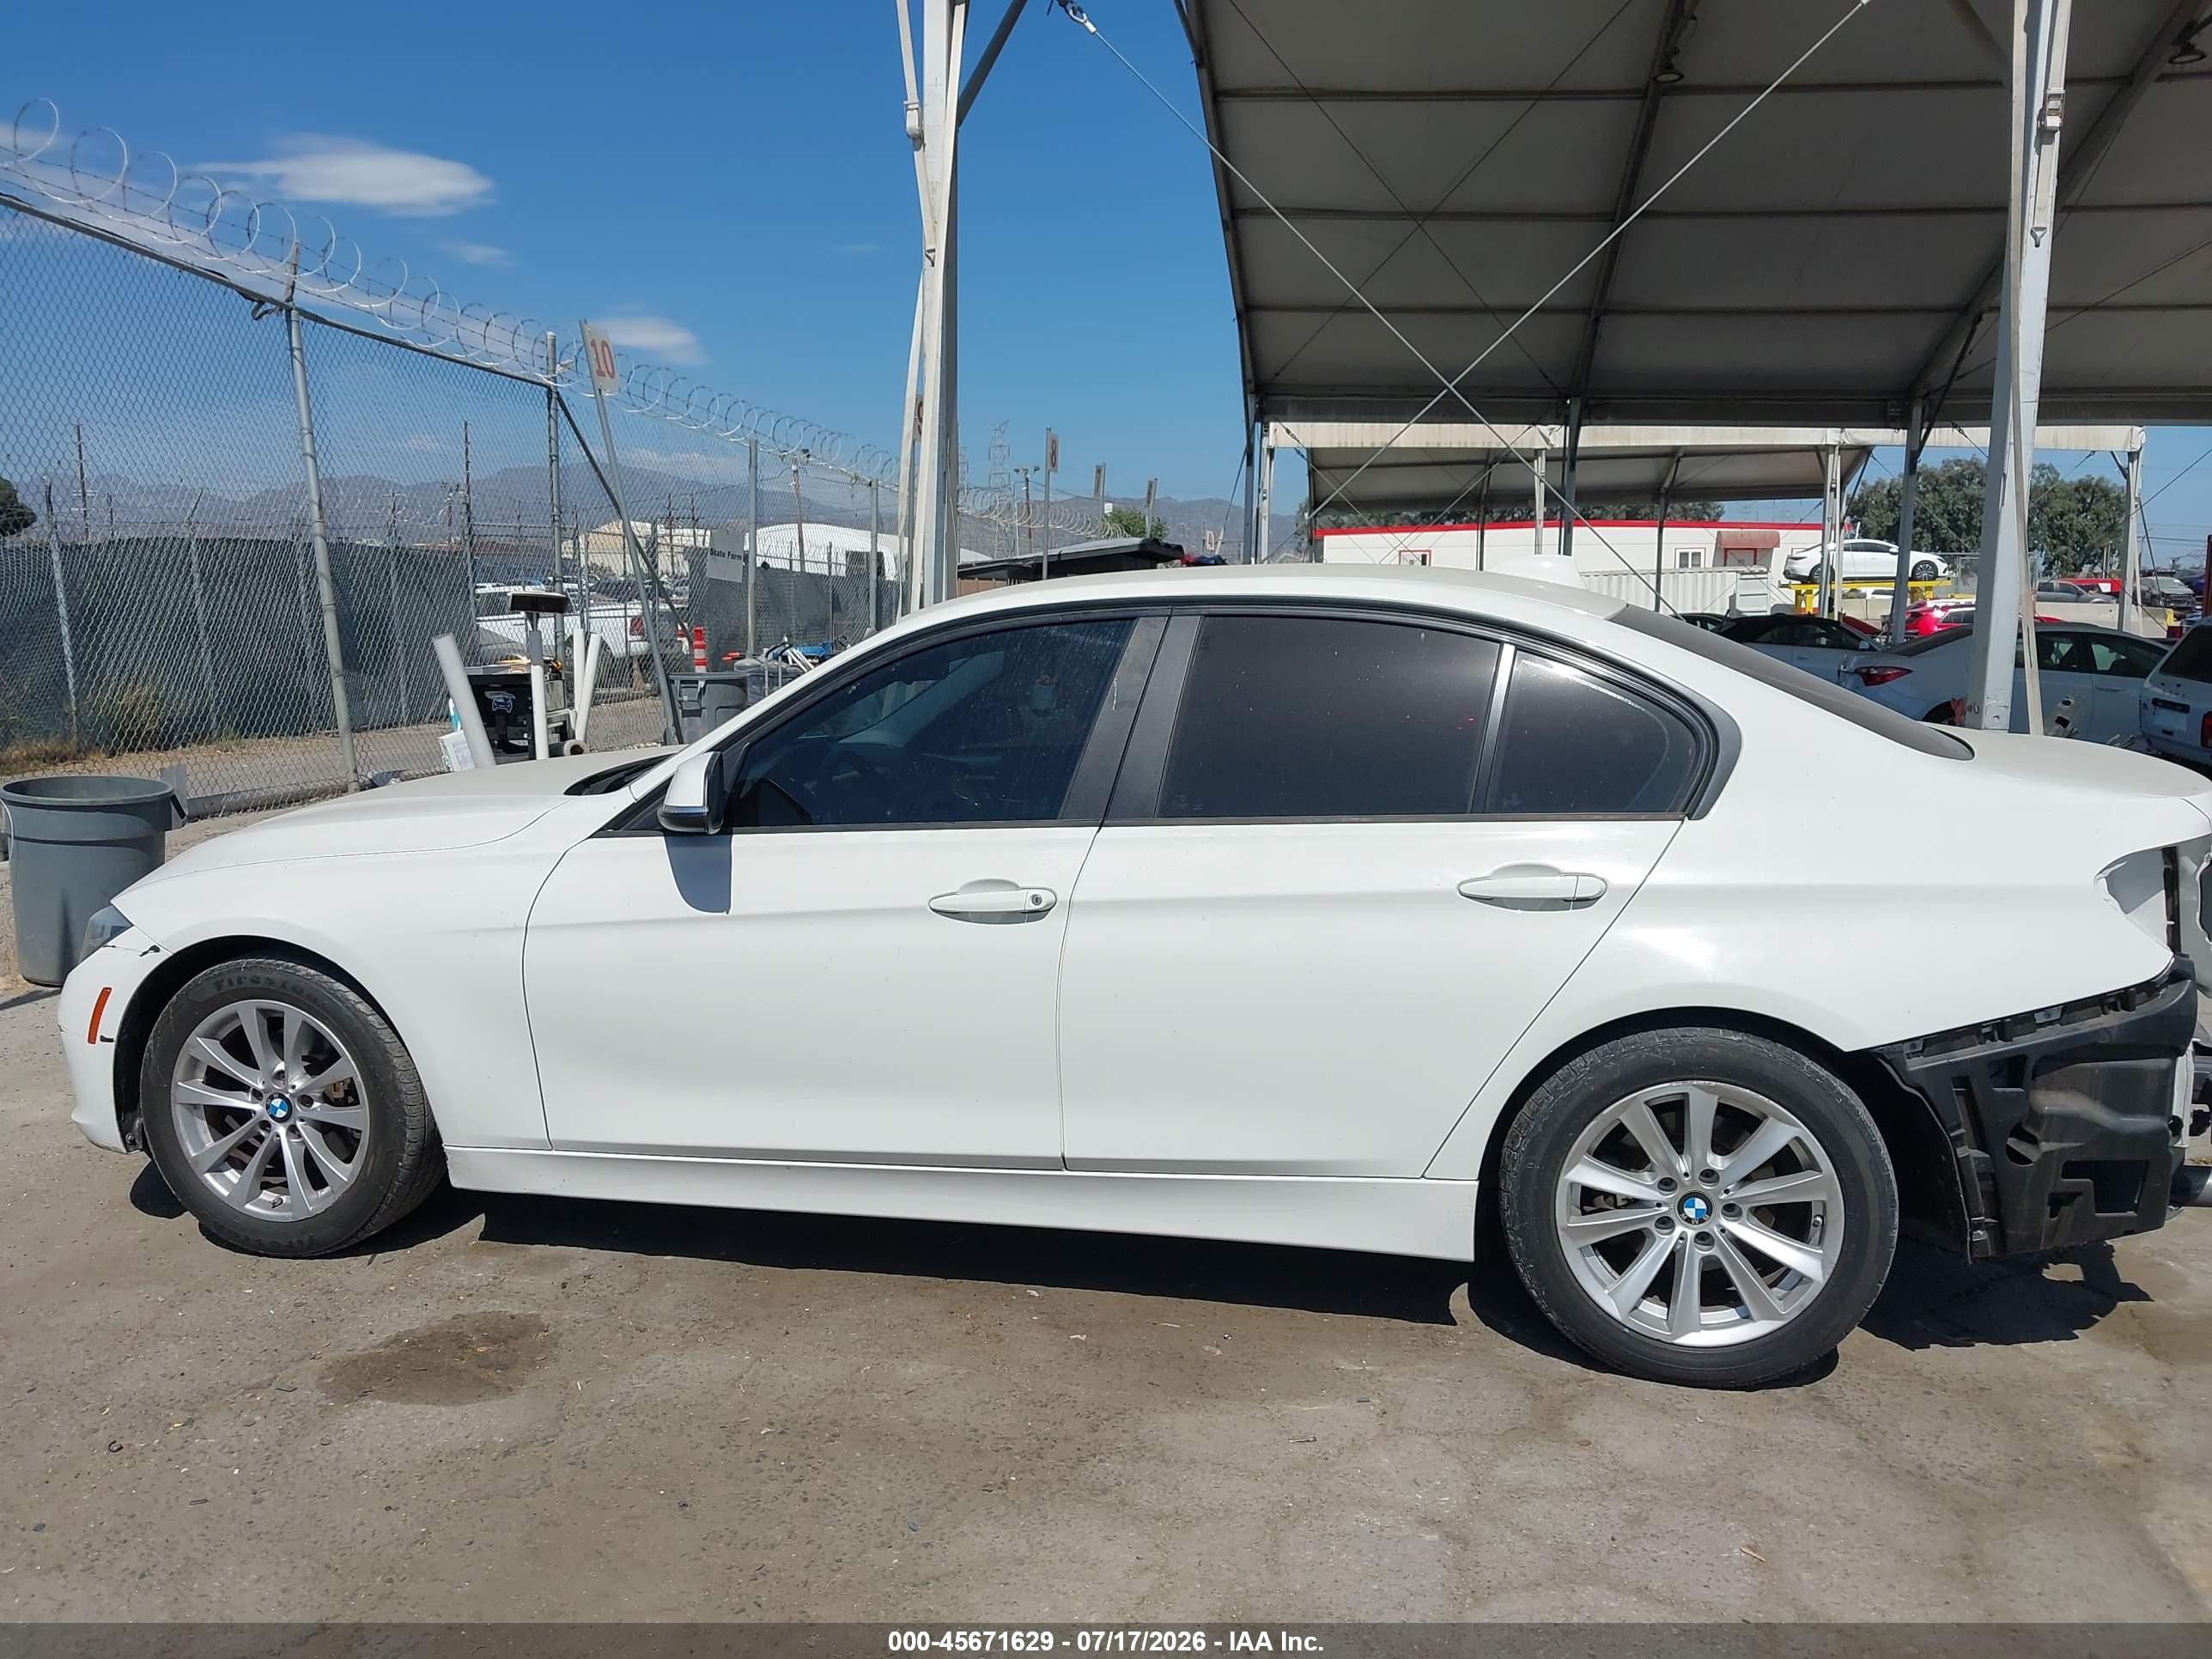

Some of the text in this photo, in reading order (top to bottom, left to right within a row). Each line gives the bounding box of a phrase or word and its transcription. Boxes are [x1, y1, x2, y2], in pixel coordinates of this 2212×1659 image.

[591, 339, 615, 379] 10
[1051, 439, 1057, 468] 8
[709, 548, 743, 561] State Farm
